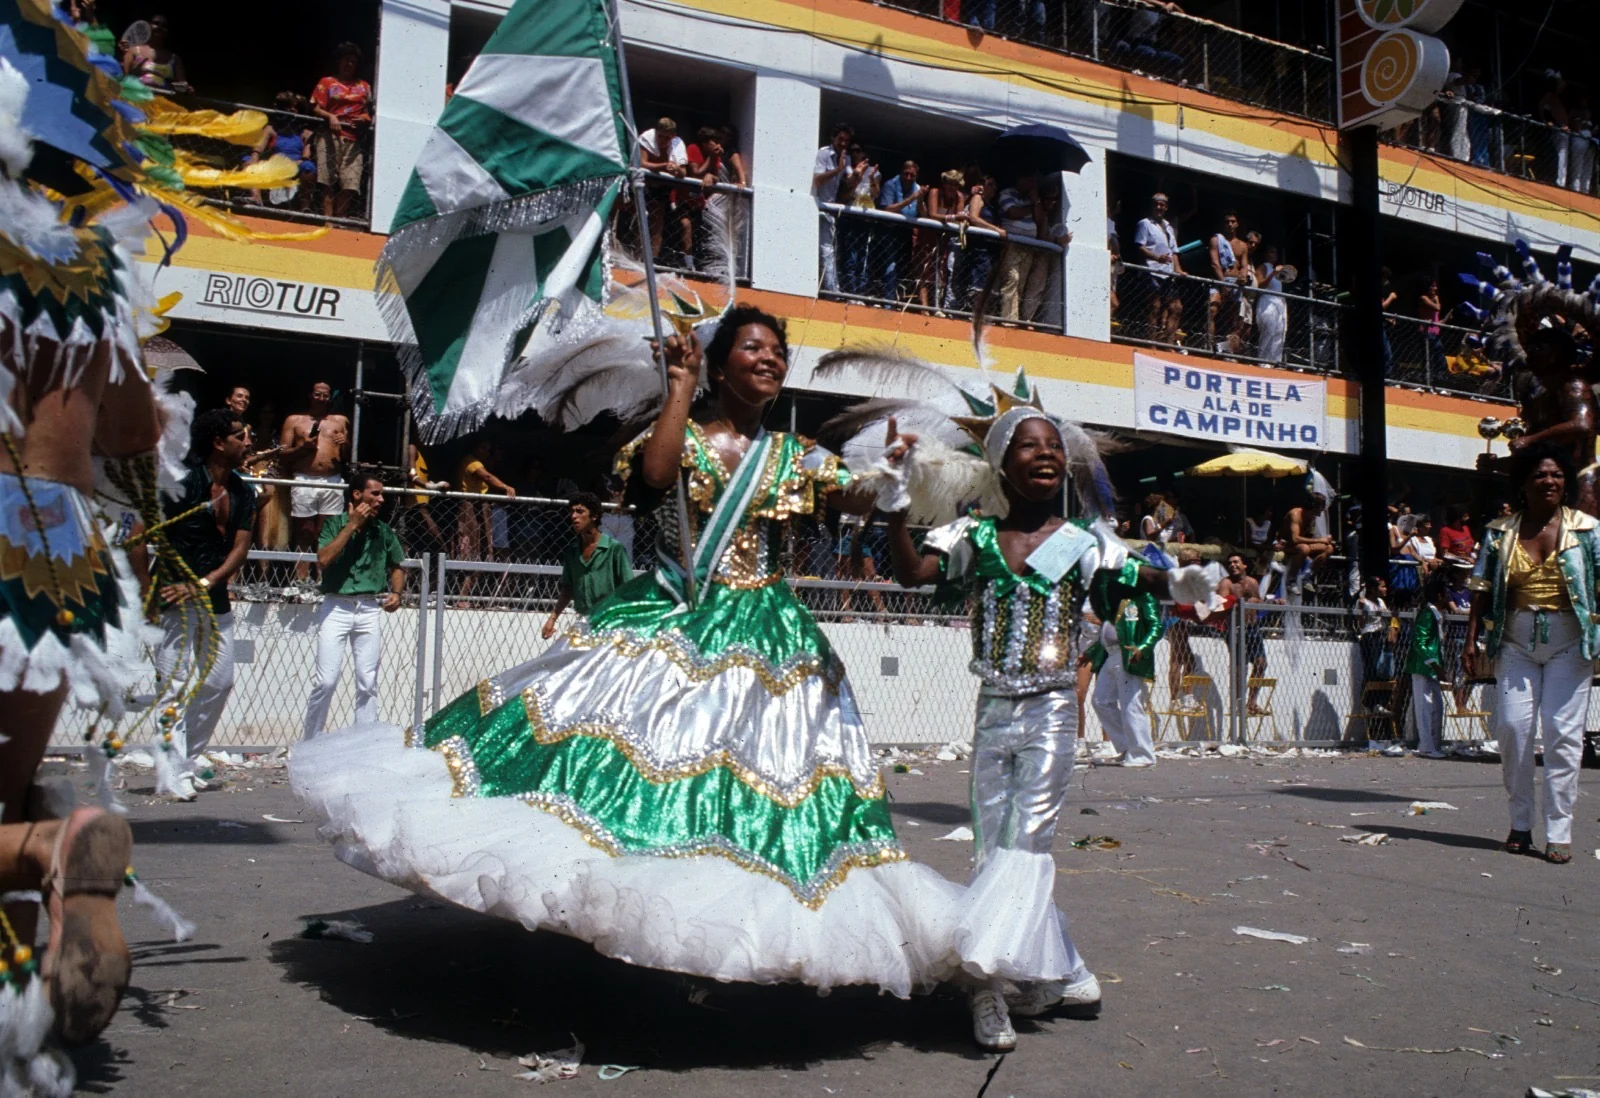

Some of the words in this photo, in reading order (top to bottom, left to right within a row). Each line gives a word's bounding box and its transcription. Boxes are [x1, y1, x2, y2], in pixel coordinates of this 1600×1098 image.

[1387, 182, 1445, 213] RIOTUR
[204, 273, 341, 317] RIOTUR
[1164, 366, 1302, 402] PORTELA
[1149, 404, 1317, 443] CAMPINHO
[1202, 395, 1241, 414] ALA
[1248, 401, 1273, 418] DE
